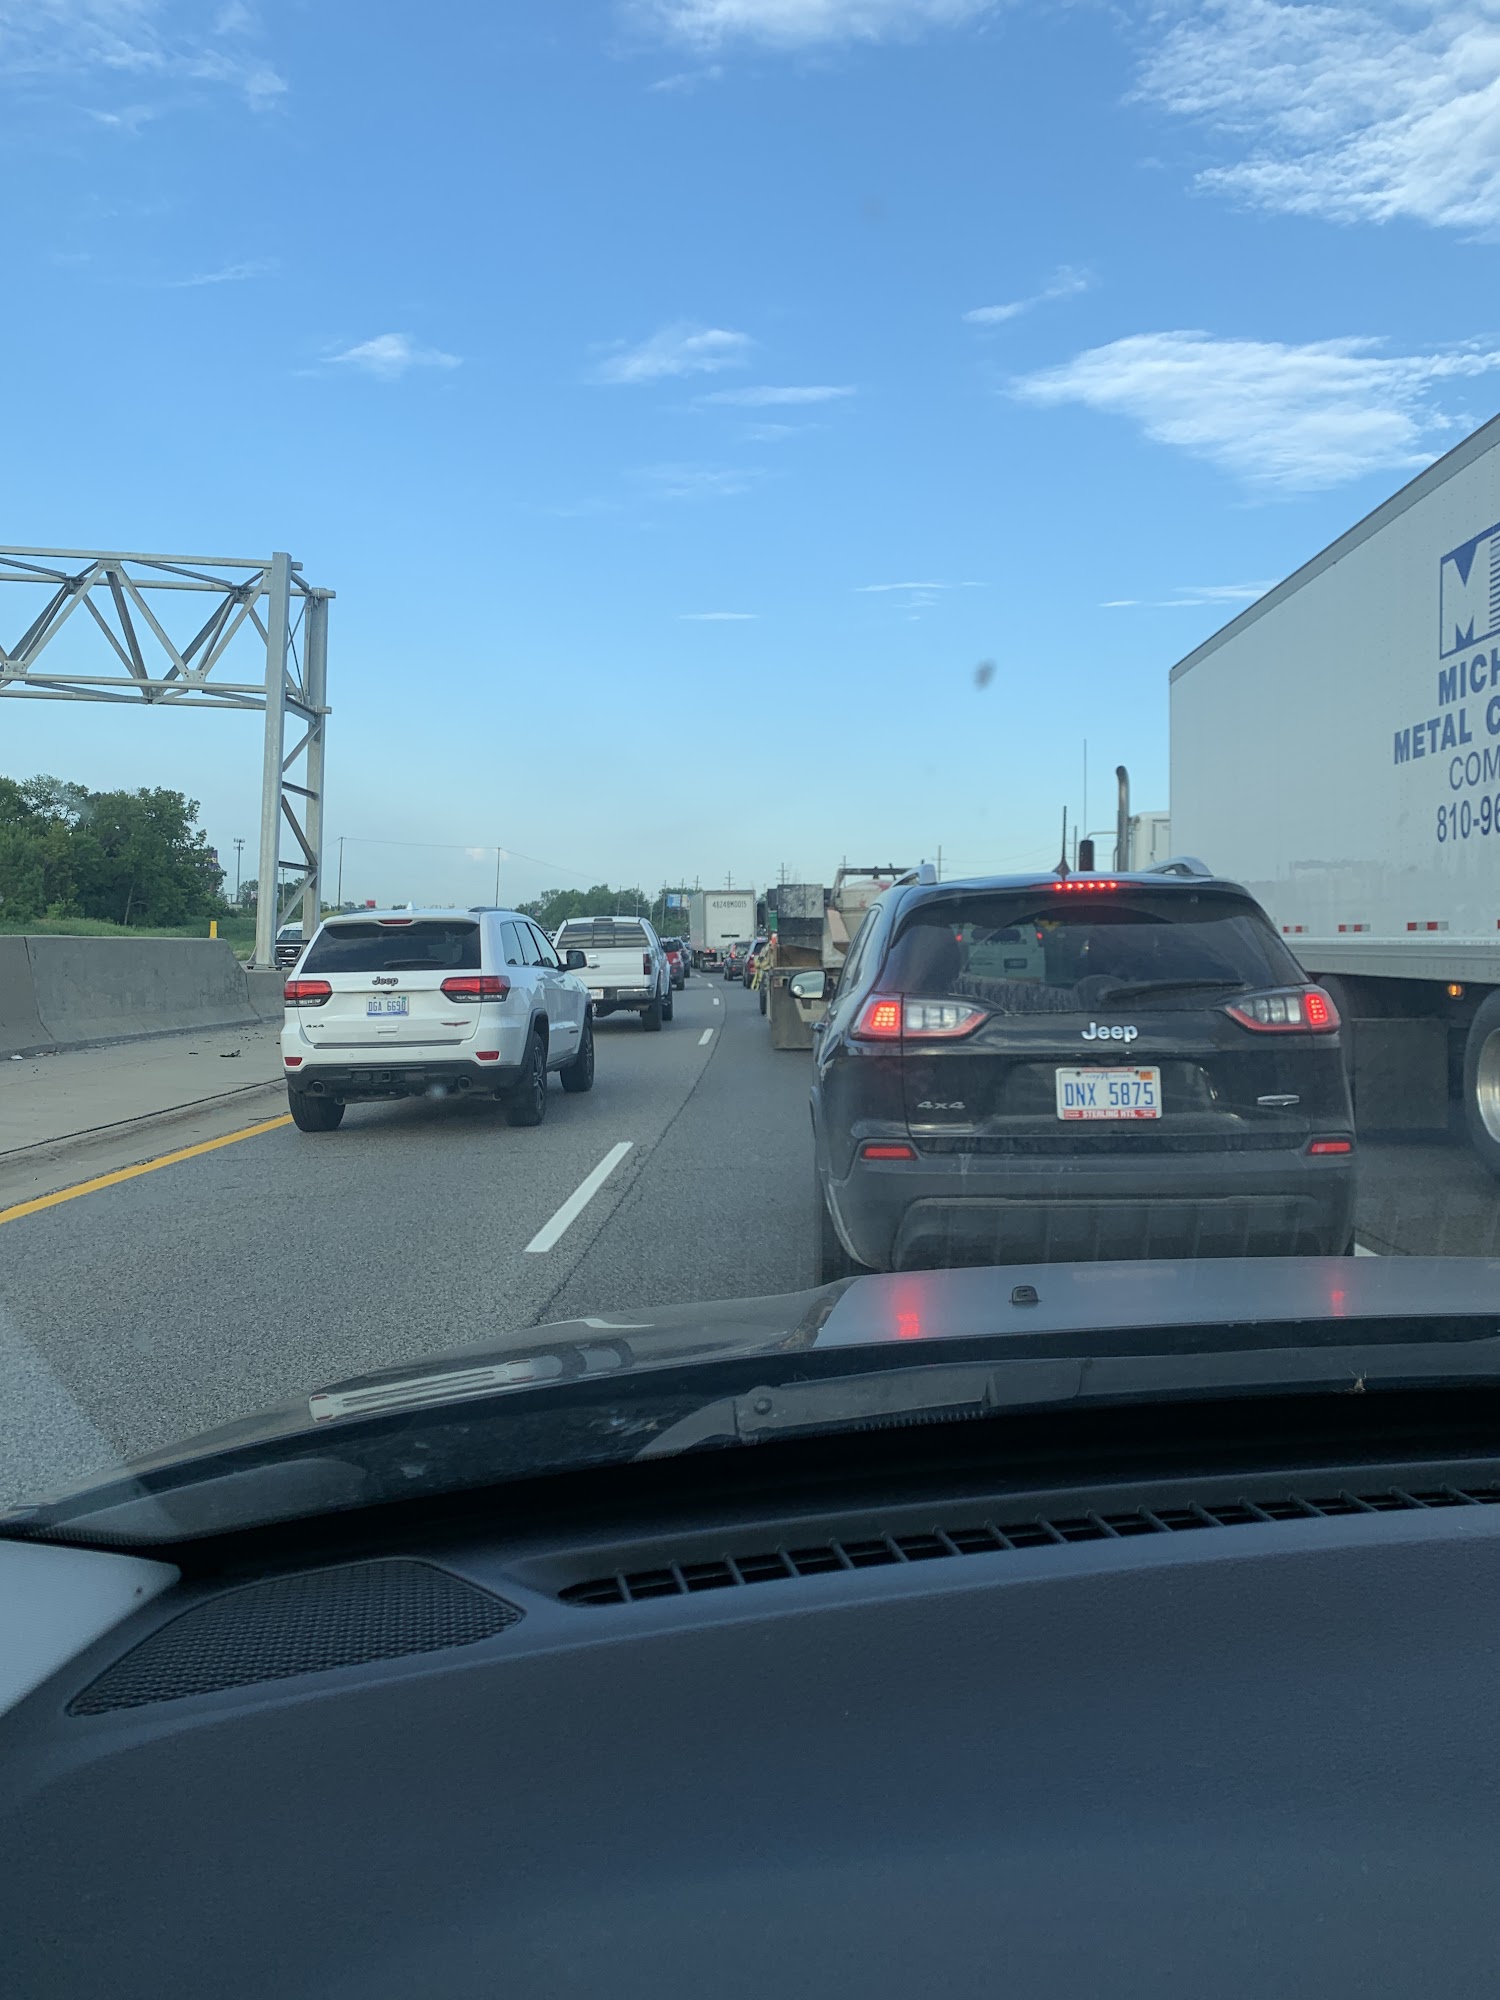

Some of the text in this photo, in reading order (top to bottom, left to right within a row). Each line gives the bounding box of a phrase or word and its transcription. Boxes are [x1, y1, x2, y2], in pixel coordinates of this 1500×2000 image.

[1394, 708, 1472, 765] METAL
[1449, 746, 1500, 790] COM
[372, 976, 399, 986] Jeep
[368, 1001, 382, 1011] DGA
[1081, 1021, 1138, 1043] Jeep
[1064, 1081, 1154, 1106] DNX 5875
[917, 1101, 966, 1110] 4x4
[1082, 1110, 1119, 1118] STERLING
